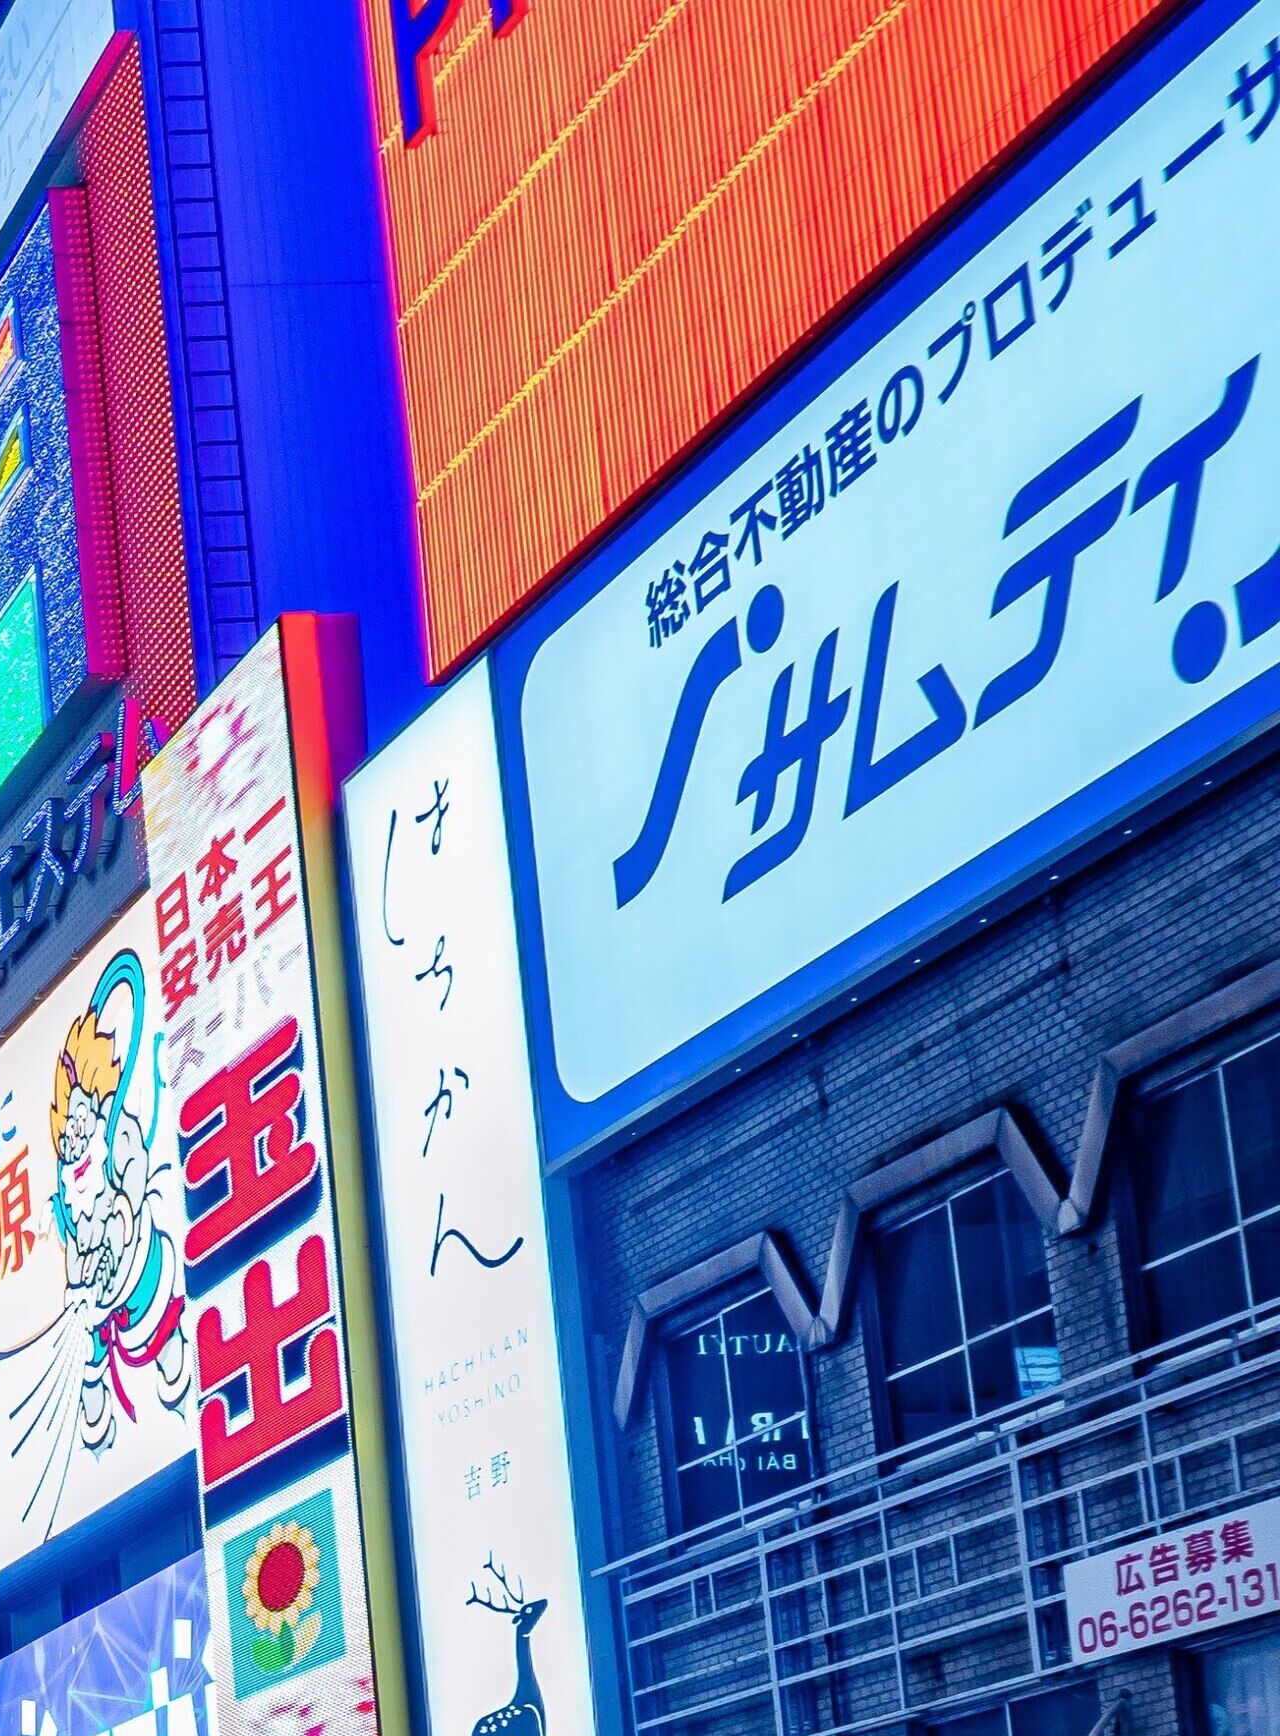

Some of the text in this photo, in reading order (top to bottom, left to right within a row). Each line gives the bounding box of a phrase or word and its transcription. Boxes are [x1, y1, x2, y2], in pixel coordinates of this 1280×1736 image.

[156, 796, 287, 953] 日本一
[161, 845, 298, 1022] 安売王
[170, 944, 305, 1090] スーパー
[385, 778, 523, 1277] はちかん
[179, 1011, 345, 1497] 玉出
[423, 1326, 530, 1398] HACHIKAN
[436, 1373, 523, 1429] YOSHINO
[463, 1449, 512, 1501] 吉野
[1115, 1519, 1255, 1596] 広告募集
